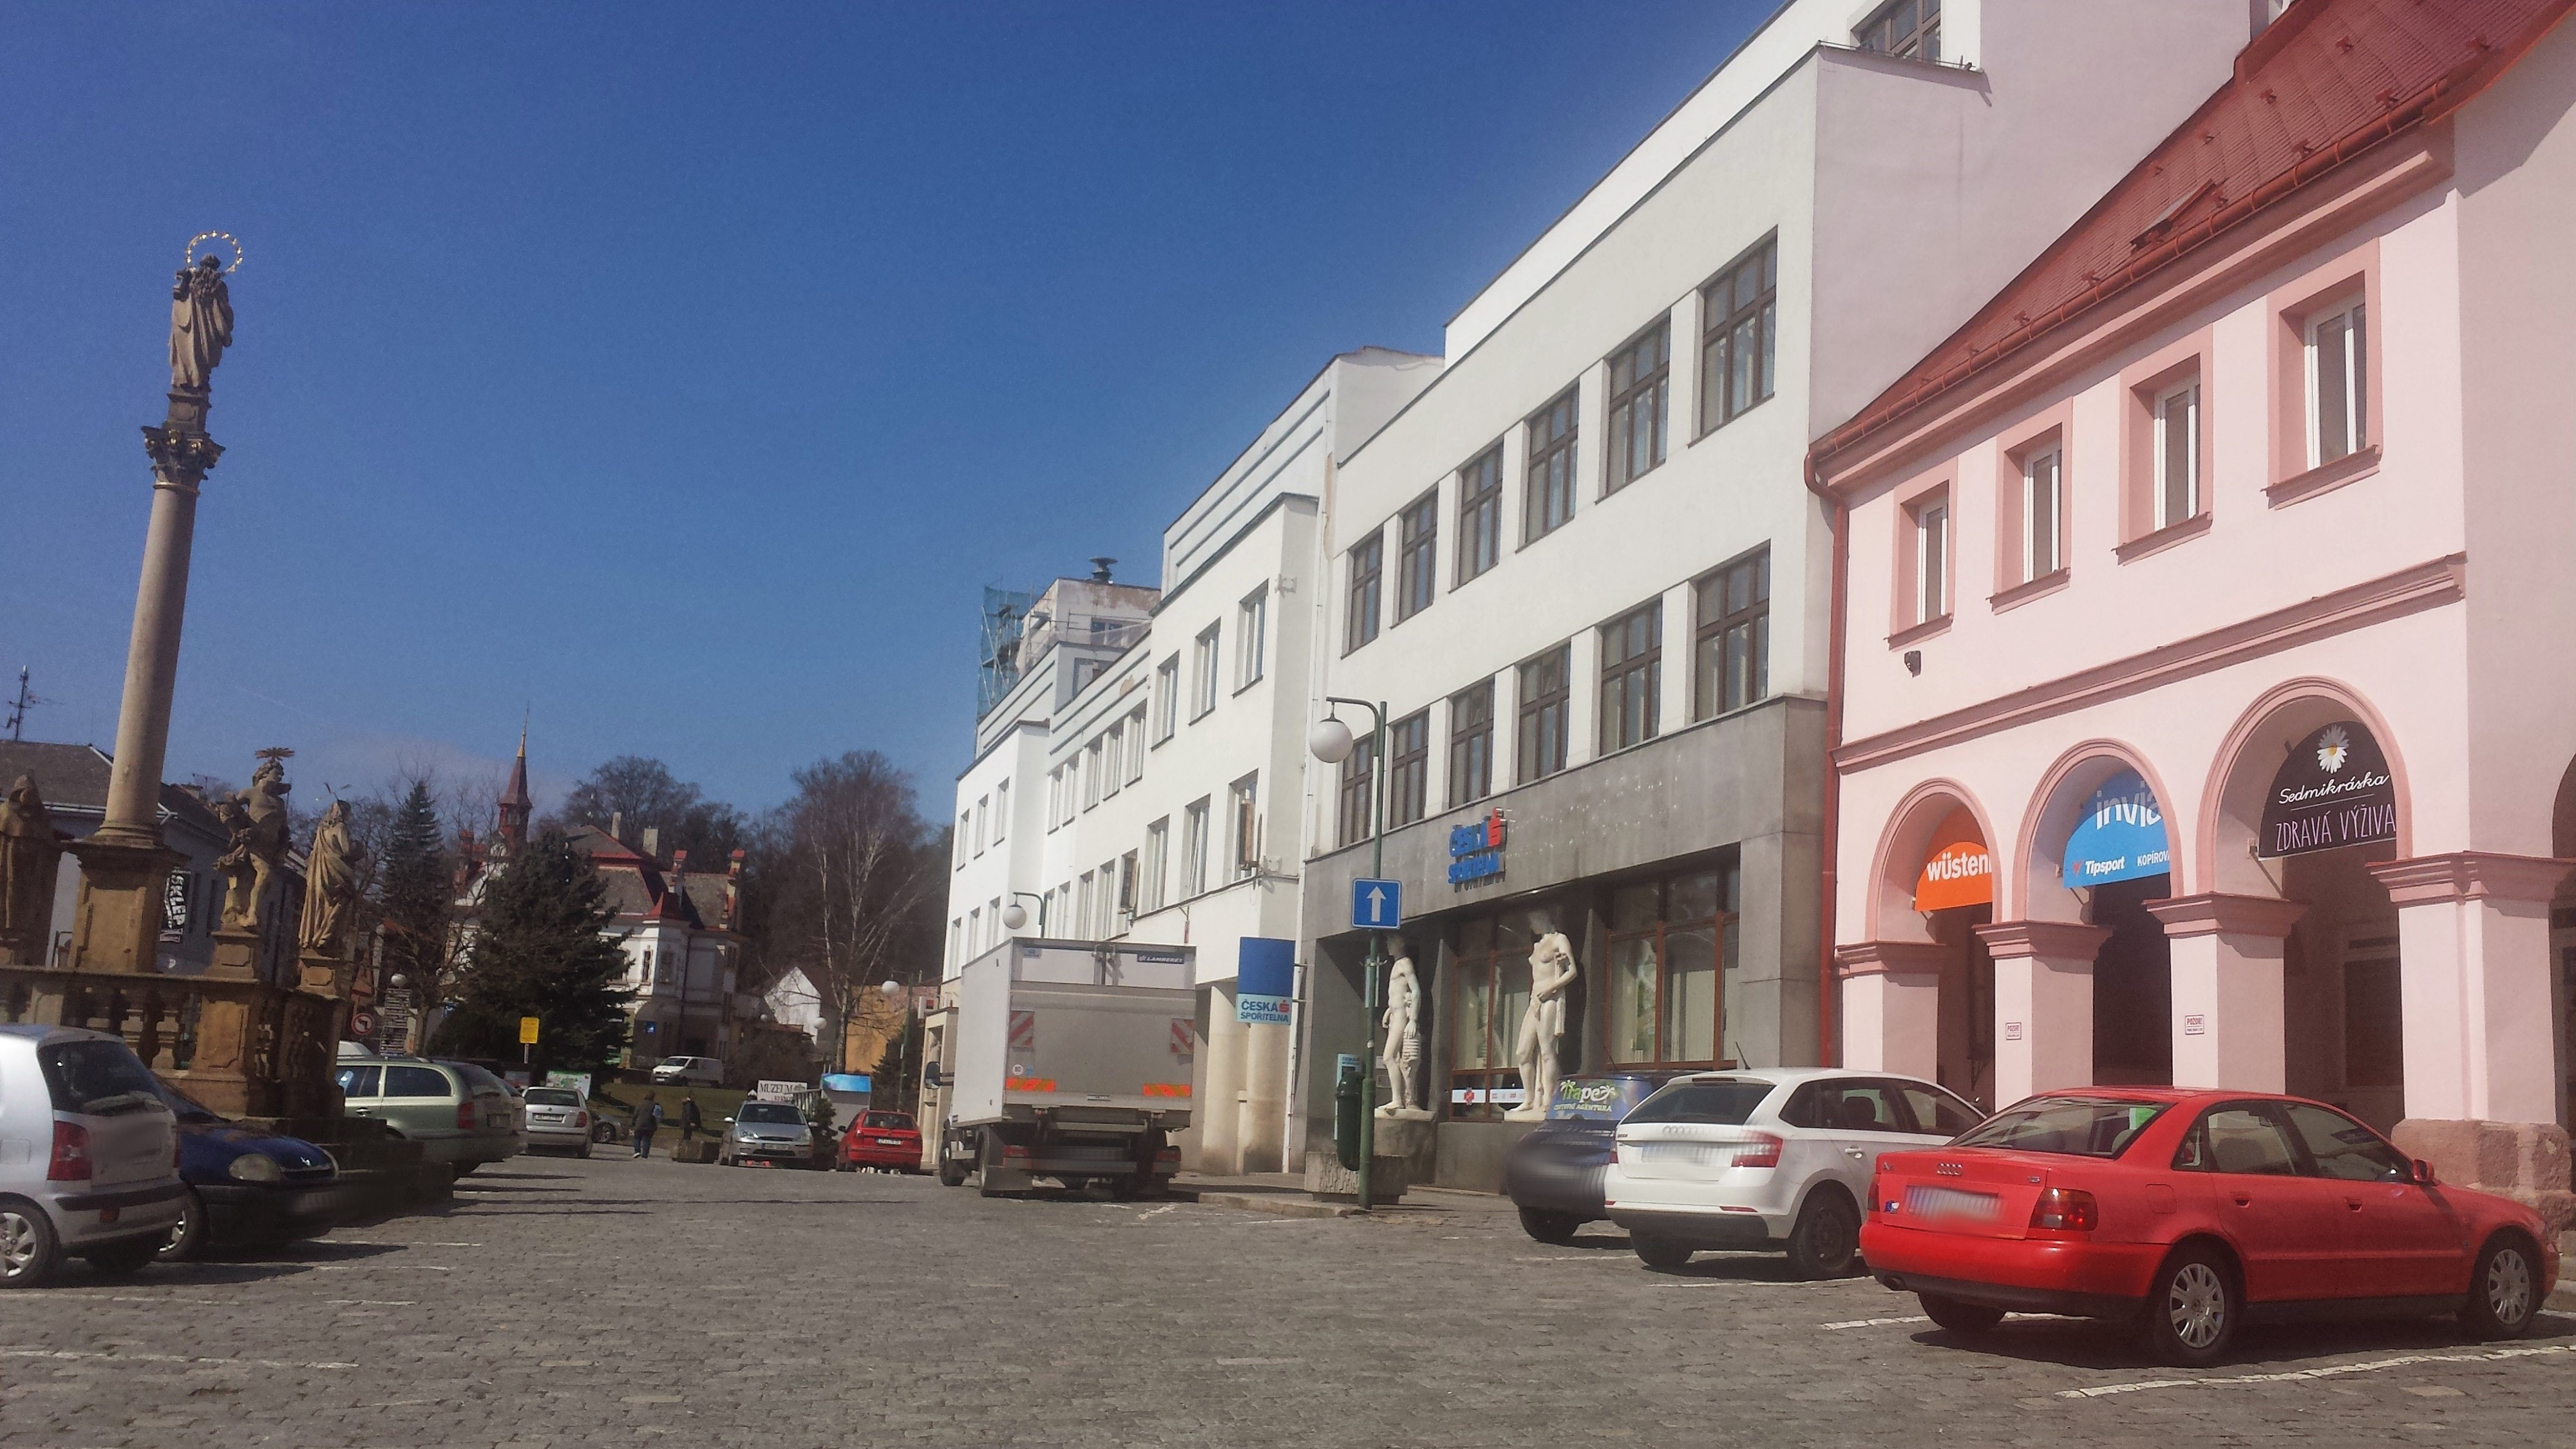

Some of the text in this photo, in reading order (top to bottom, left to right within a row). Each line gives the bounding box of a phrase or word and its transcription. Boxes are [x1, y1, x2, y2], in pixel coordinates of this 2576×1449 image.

[2278, 771, 2390, 804] Sedmikráska
[2276, 803, 2396, 851] ZDRAVÁ VÝŽIVA
[2085, 849, 2170, 876] Tipsport KOPÍROV
[1241, 999, 1278, 1012] ČESKÁ
[1240, 1012, 1289, 1022] SPOŘITELNA
[760, 1083, 793, 1094] MUZEUM
